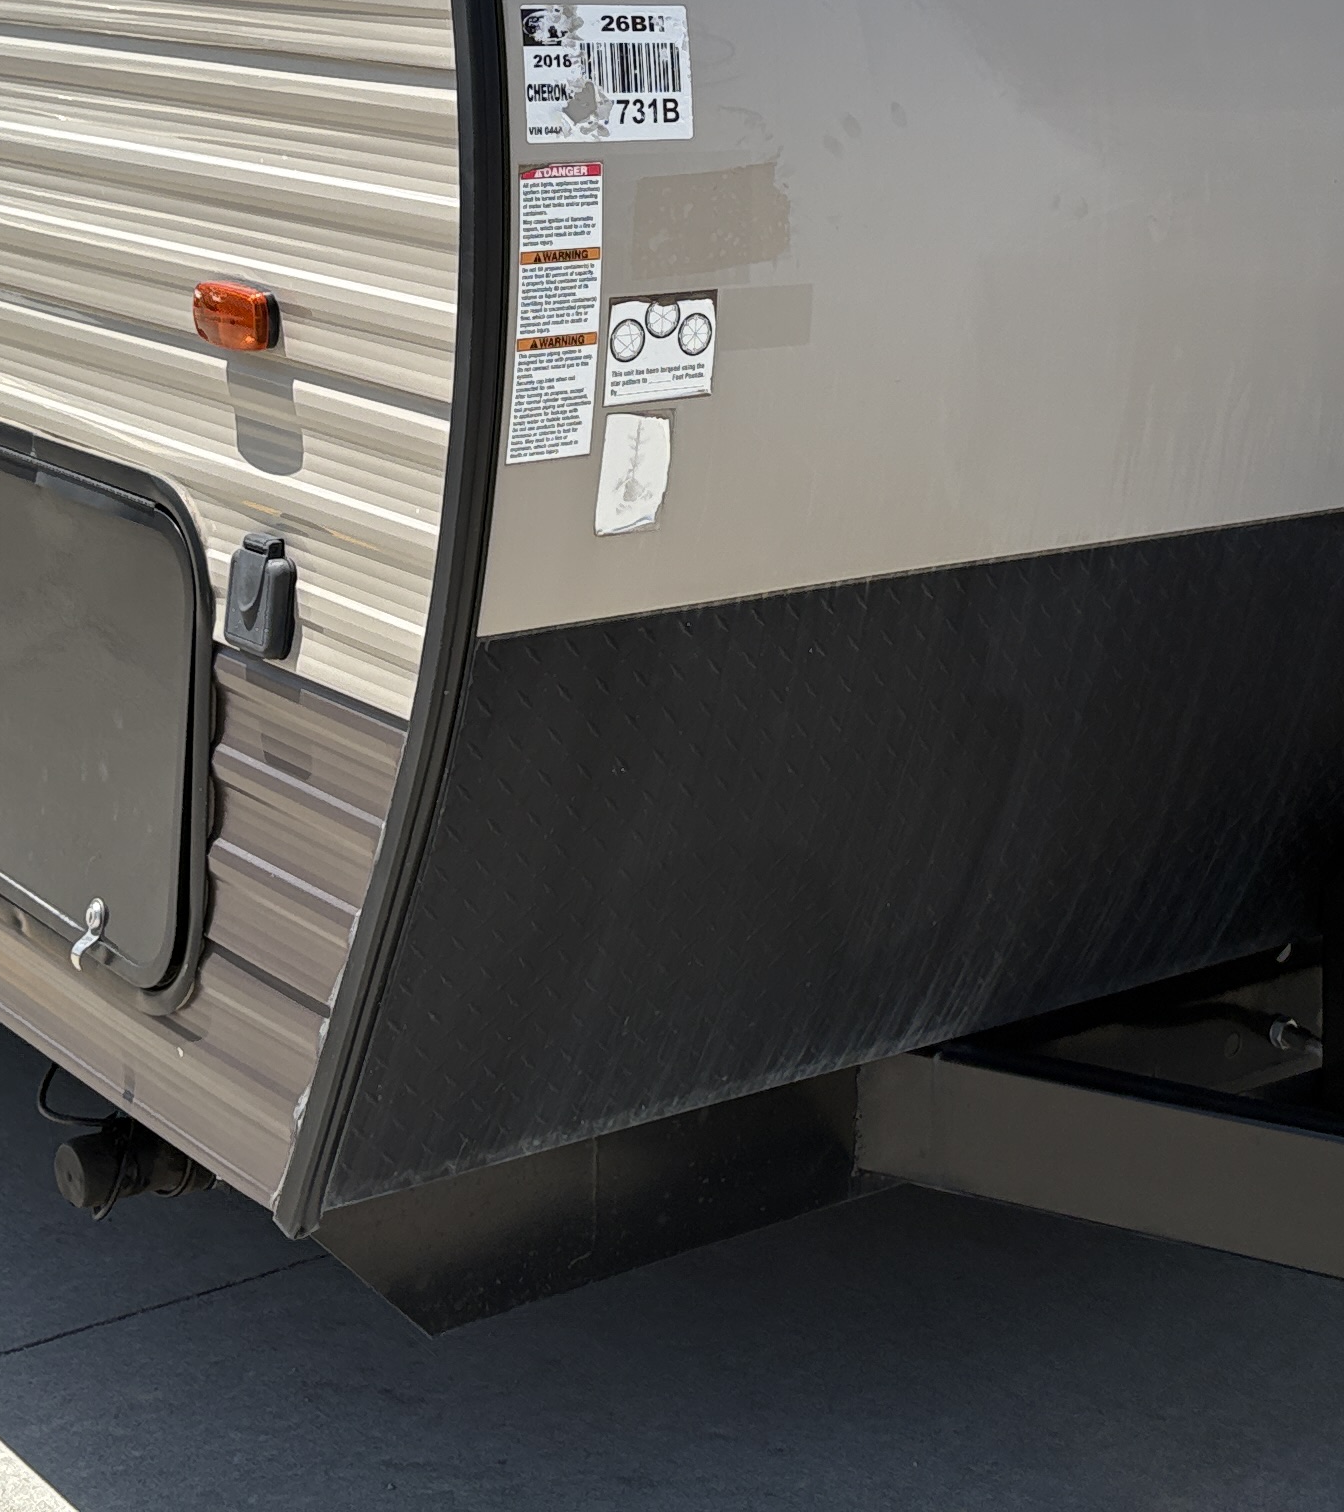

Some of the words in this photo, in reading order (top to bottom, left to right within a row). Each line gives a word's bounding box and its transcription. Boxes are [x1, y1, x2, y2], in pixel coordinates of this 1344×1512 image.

[543, 166, 588, 178] DANGER
[543, 249, 589, 262] WARNING
[540, 334, 585, 349] WARNING
